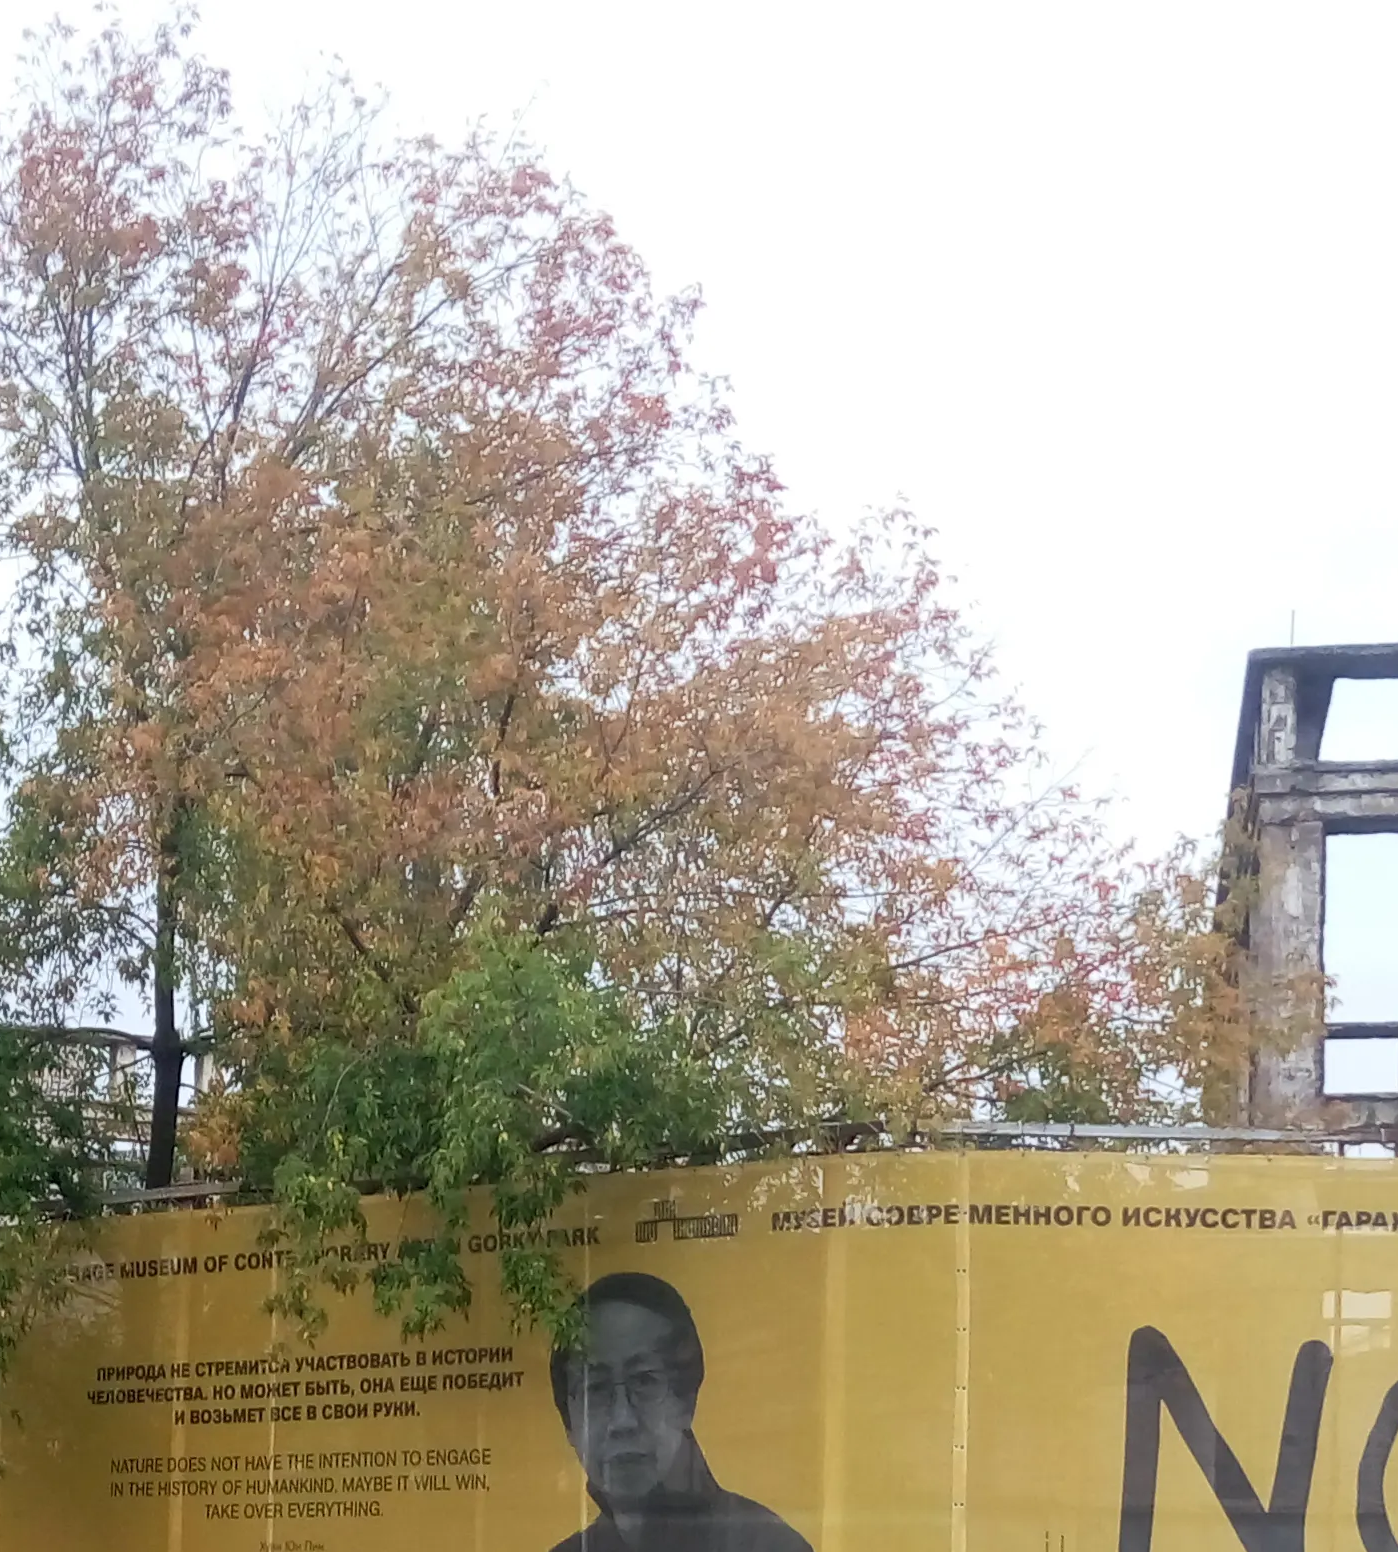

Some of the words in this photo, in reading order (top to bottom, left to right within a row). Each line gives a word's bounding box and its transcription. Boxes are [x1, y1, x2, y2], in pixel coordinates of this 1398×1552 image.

[1121, 1205, 1297, 1230] ИСКУССТВА
[120, 1256, 198, 1280] MUSEUM
[204, 1254, 229, 1274] OF
[97, 1364, 167, 1382] ПРИРОДА
[171, 1362, 191, 1378] НЕ
[195, 1358, 290, 1377] СТРЕМИТСЯ
[295, 1351, 411, 1373] УЧАСТВОВАТЬ
[416, 1351, 427, 1366] В
[432, 1347, 514, 1366] ИСТОРИИ
[87, 1385, 208, 1405] ЧЕЛОВЕЧЕСТВА.
[213, 1384, 236, 1401] НО
[241, 1381, 301, 1399] МОЖЕТ
[305, 1378, 355, 1398] БЫТЬ,
[360, 1377, 396, 1394] ОНА
[400, 1374, 438, 1394] ЕЩЕ
[443, 1371, 525, 1391] ПОБЕДИТ
[175, 1410, 186, 1426] И
[190, 1407, 266, 1425] ВОЗЬМЕТ
[271, 1406, 302, 1422] ВСЕ
[307, 1405, 317, 1420] В
[322, 1403, 369, 1420] СВОИ
[373, 1401, 421, 1419] РУКИ.
[110, 1457, 163, 1474] NATURE
[167, 1456, 207, 1473] DOES
[211, 1455, 241, 1472] NOT
[245, 1454, 283, 1471] HAVE
[287, 1453, 314, 1471] THE
[319, 1450, 397, 1469] INTENTION
[403, 1450, 422, 1466] TO
[426, 1448, 492, 1466] ENGAGE
[110, 1482, 124, 1497] IN
[129, 1481, 153, 1497] THE
[158, 1480, 218, 1497] HISTORY
[222, 1480, 243, 1496] OF
[342, 1475, 393, 1493] MAYBE
[397, 1475, 409, 1491] IT
[414, 1475, 451, 1491] WILL
[456, 1473, 490, 1492] WIN,
[205, 1503, 239, 1519] TAKE
[244, 1503, 283, 1519] OVER
[288, 1500, 384, 1519] EVERYTHING.
